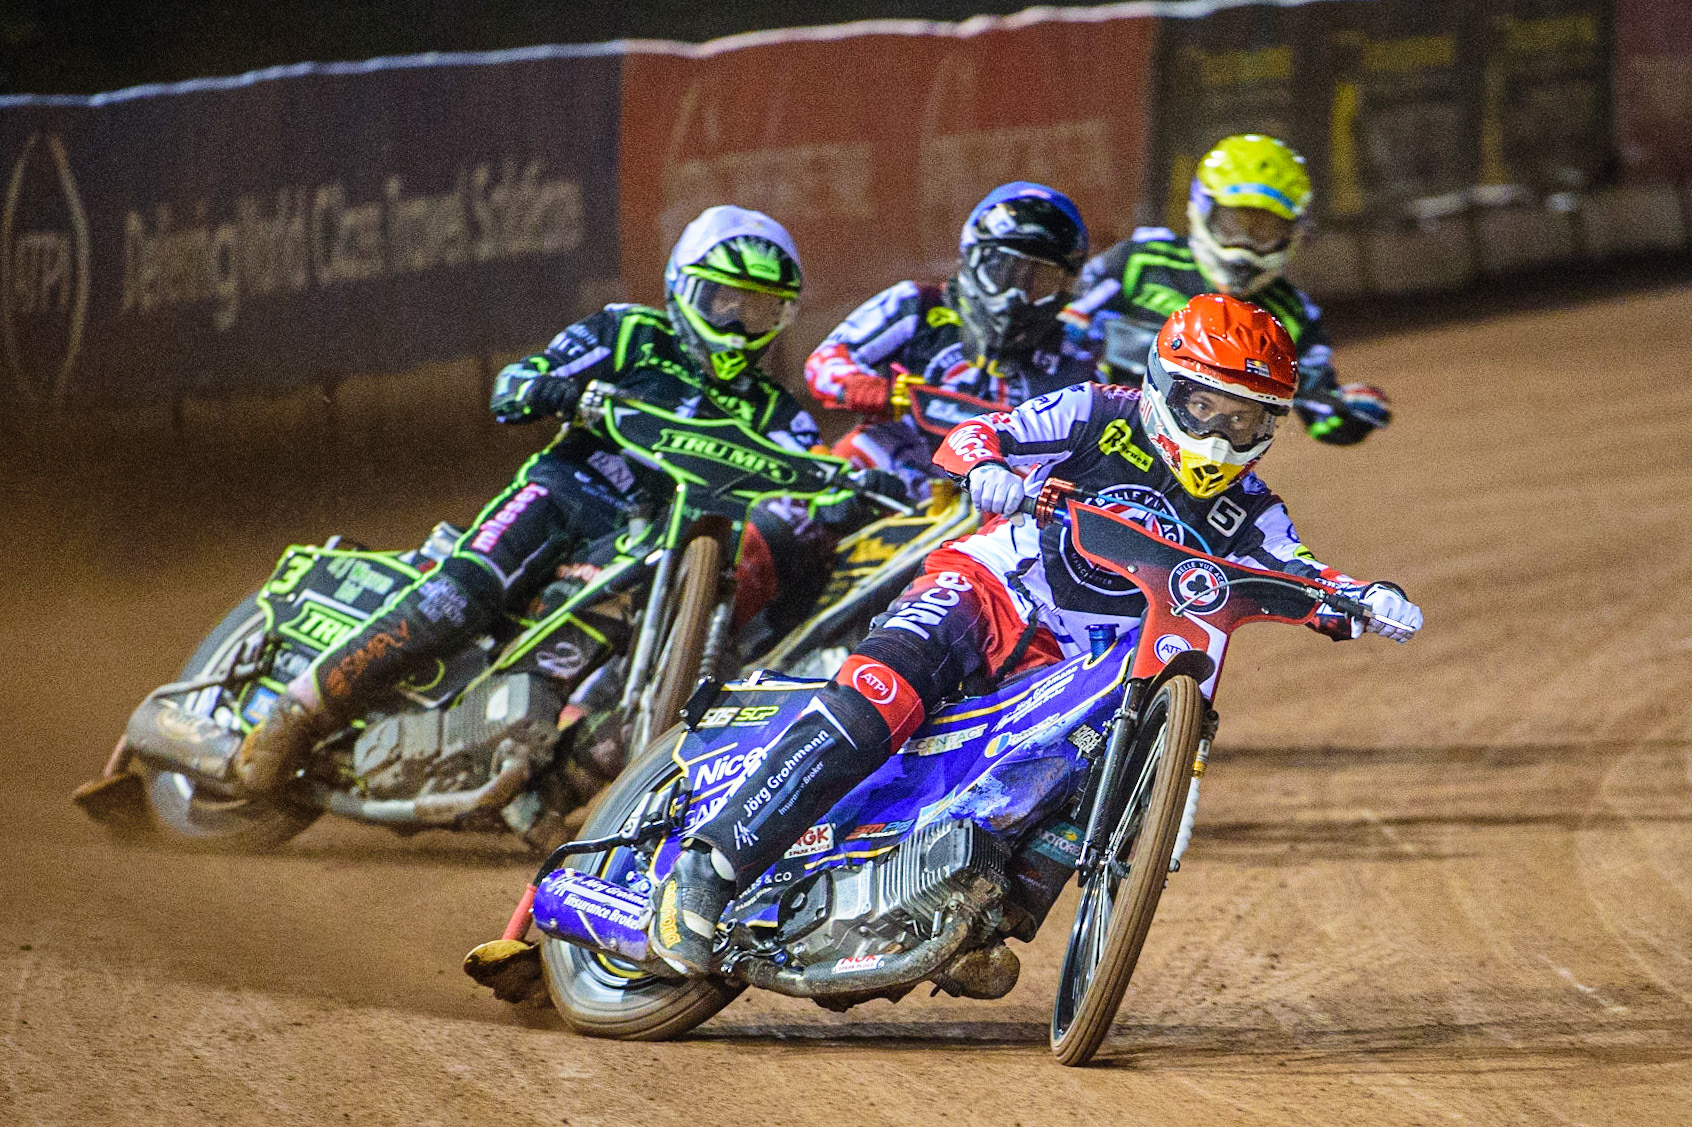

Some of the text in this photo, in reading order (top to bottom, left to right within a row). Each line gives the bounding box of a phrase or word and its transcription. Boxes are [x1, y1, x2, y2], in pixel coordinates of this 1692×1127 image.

[947, 424, 993, 462] Nice
[1210, 498, 1242, 533] 5
[268, 554, 316, 594] 3
[1176, 562, 1196, 575] BELLE
[1199, 563, 1214, 572] VUE
[883, 571, 973, 641] Nice
[859, 673, 889, 696] ATPI
[735, 706, 779, 721] SGP
[693, 747, 764, 791] Nice
[743, 730, 830, 818] Jörg Grohmann
[803, 761, 824, 785] Broker
[796, 826, 829, 846] GK
[764, 874, 772, 884] &
[774, 871, 792, 883] CO
[563, 893, 610, 919] Insurance
